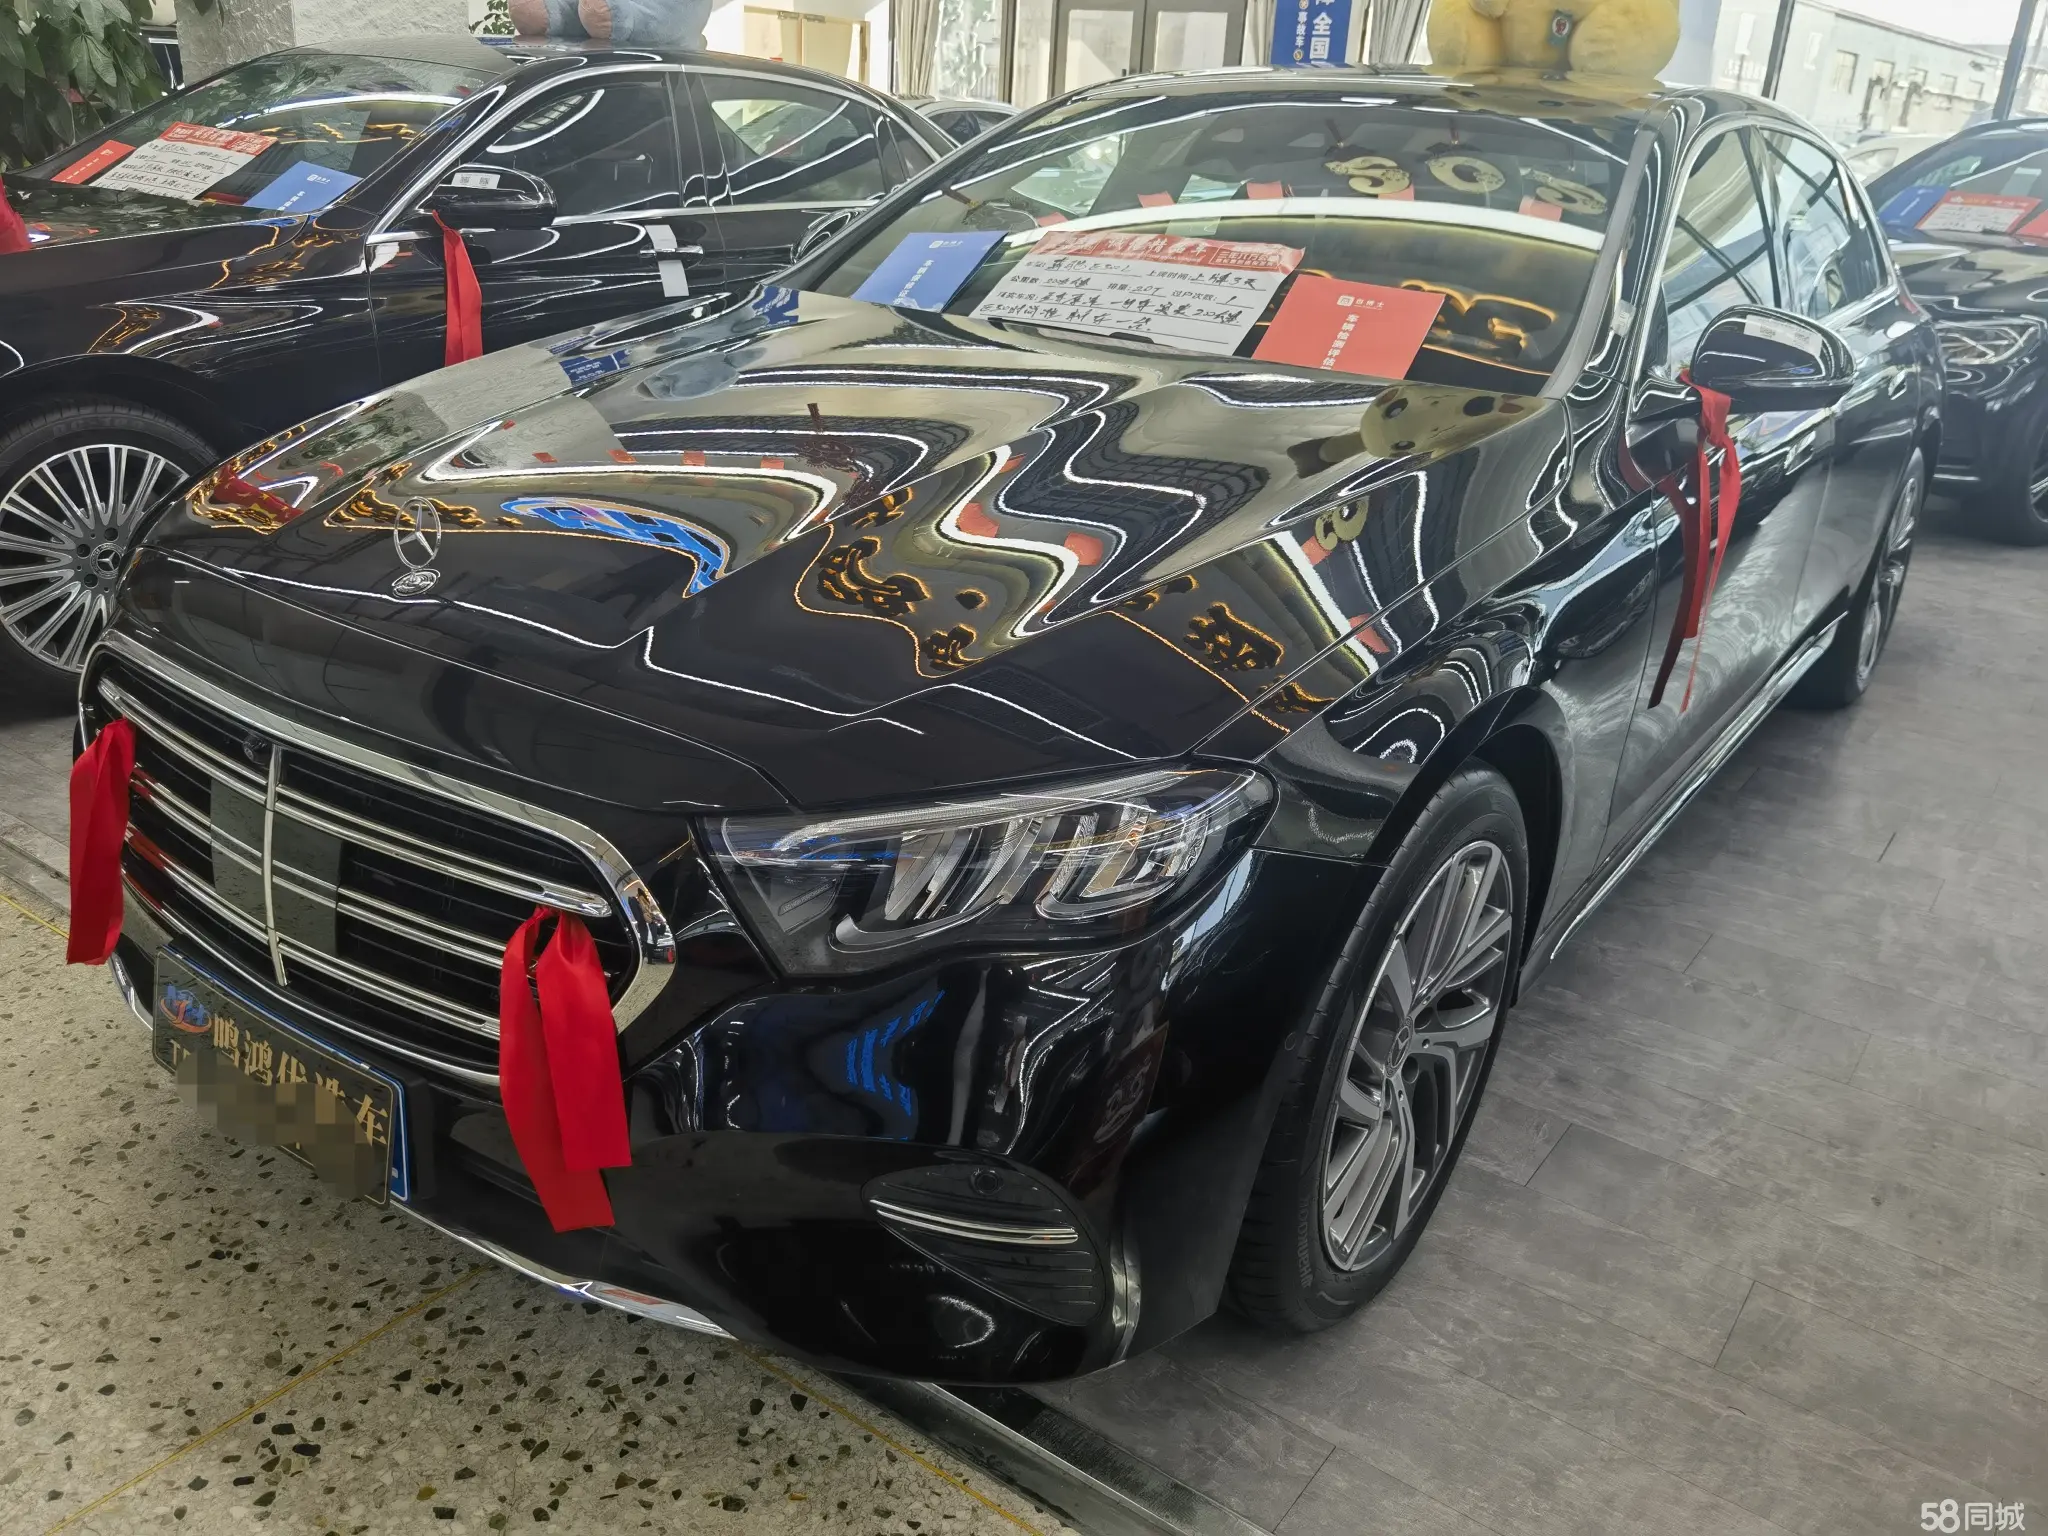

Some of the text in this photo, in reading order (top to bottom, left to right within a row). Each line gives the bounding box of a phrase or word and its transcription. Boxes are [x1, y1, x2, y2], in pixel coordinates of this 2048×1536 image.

[1295, 11, 1308, 48] 事故车
[1310, 0, 1336, 60] 全国
[1320, 313, 1360, 371] 车辆检测评估
